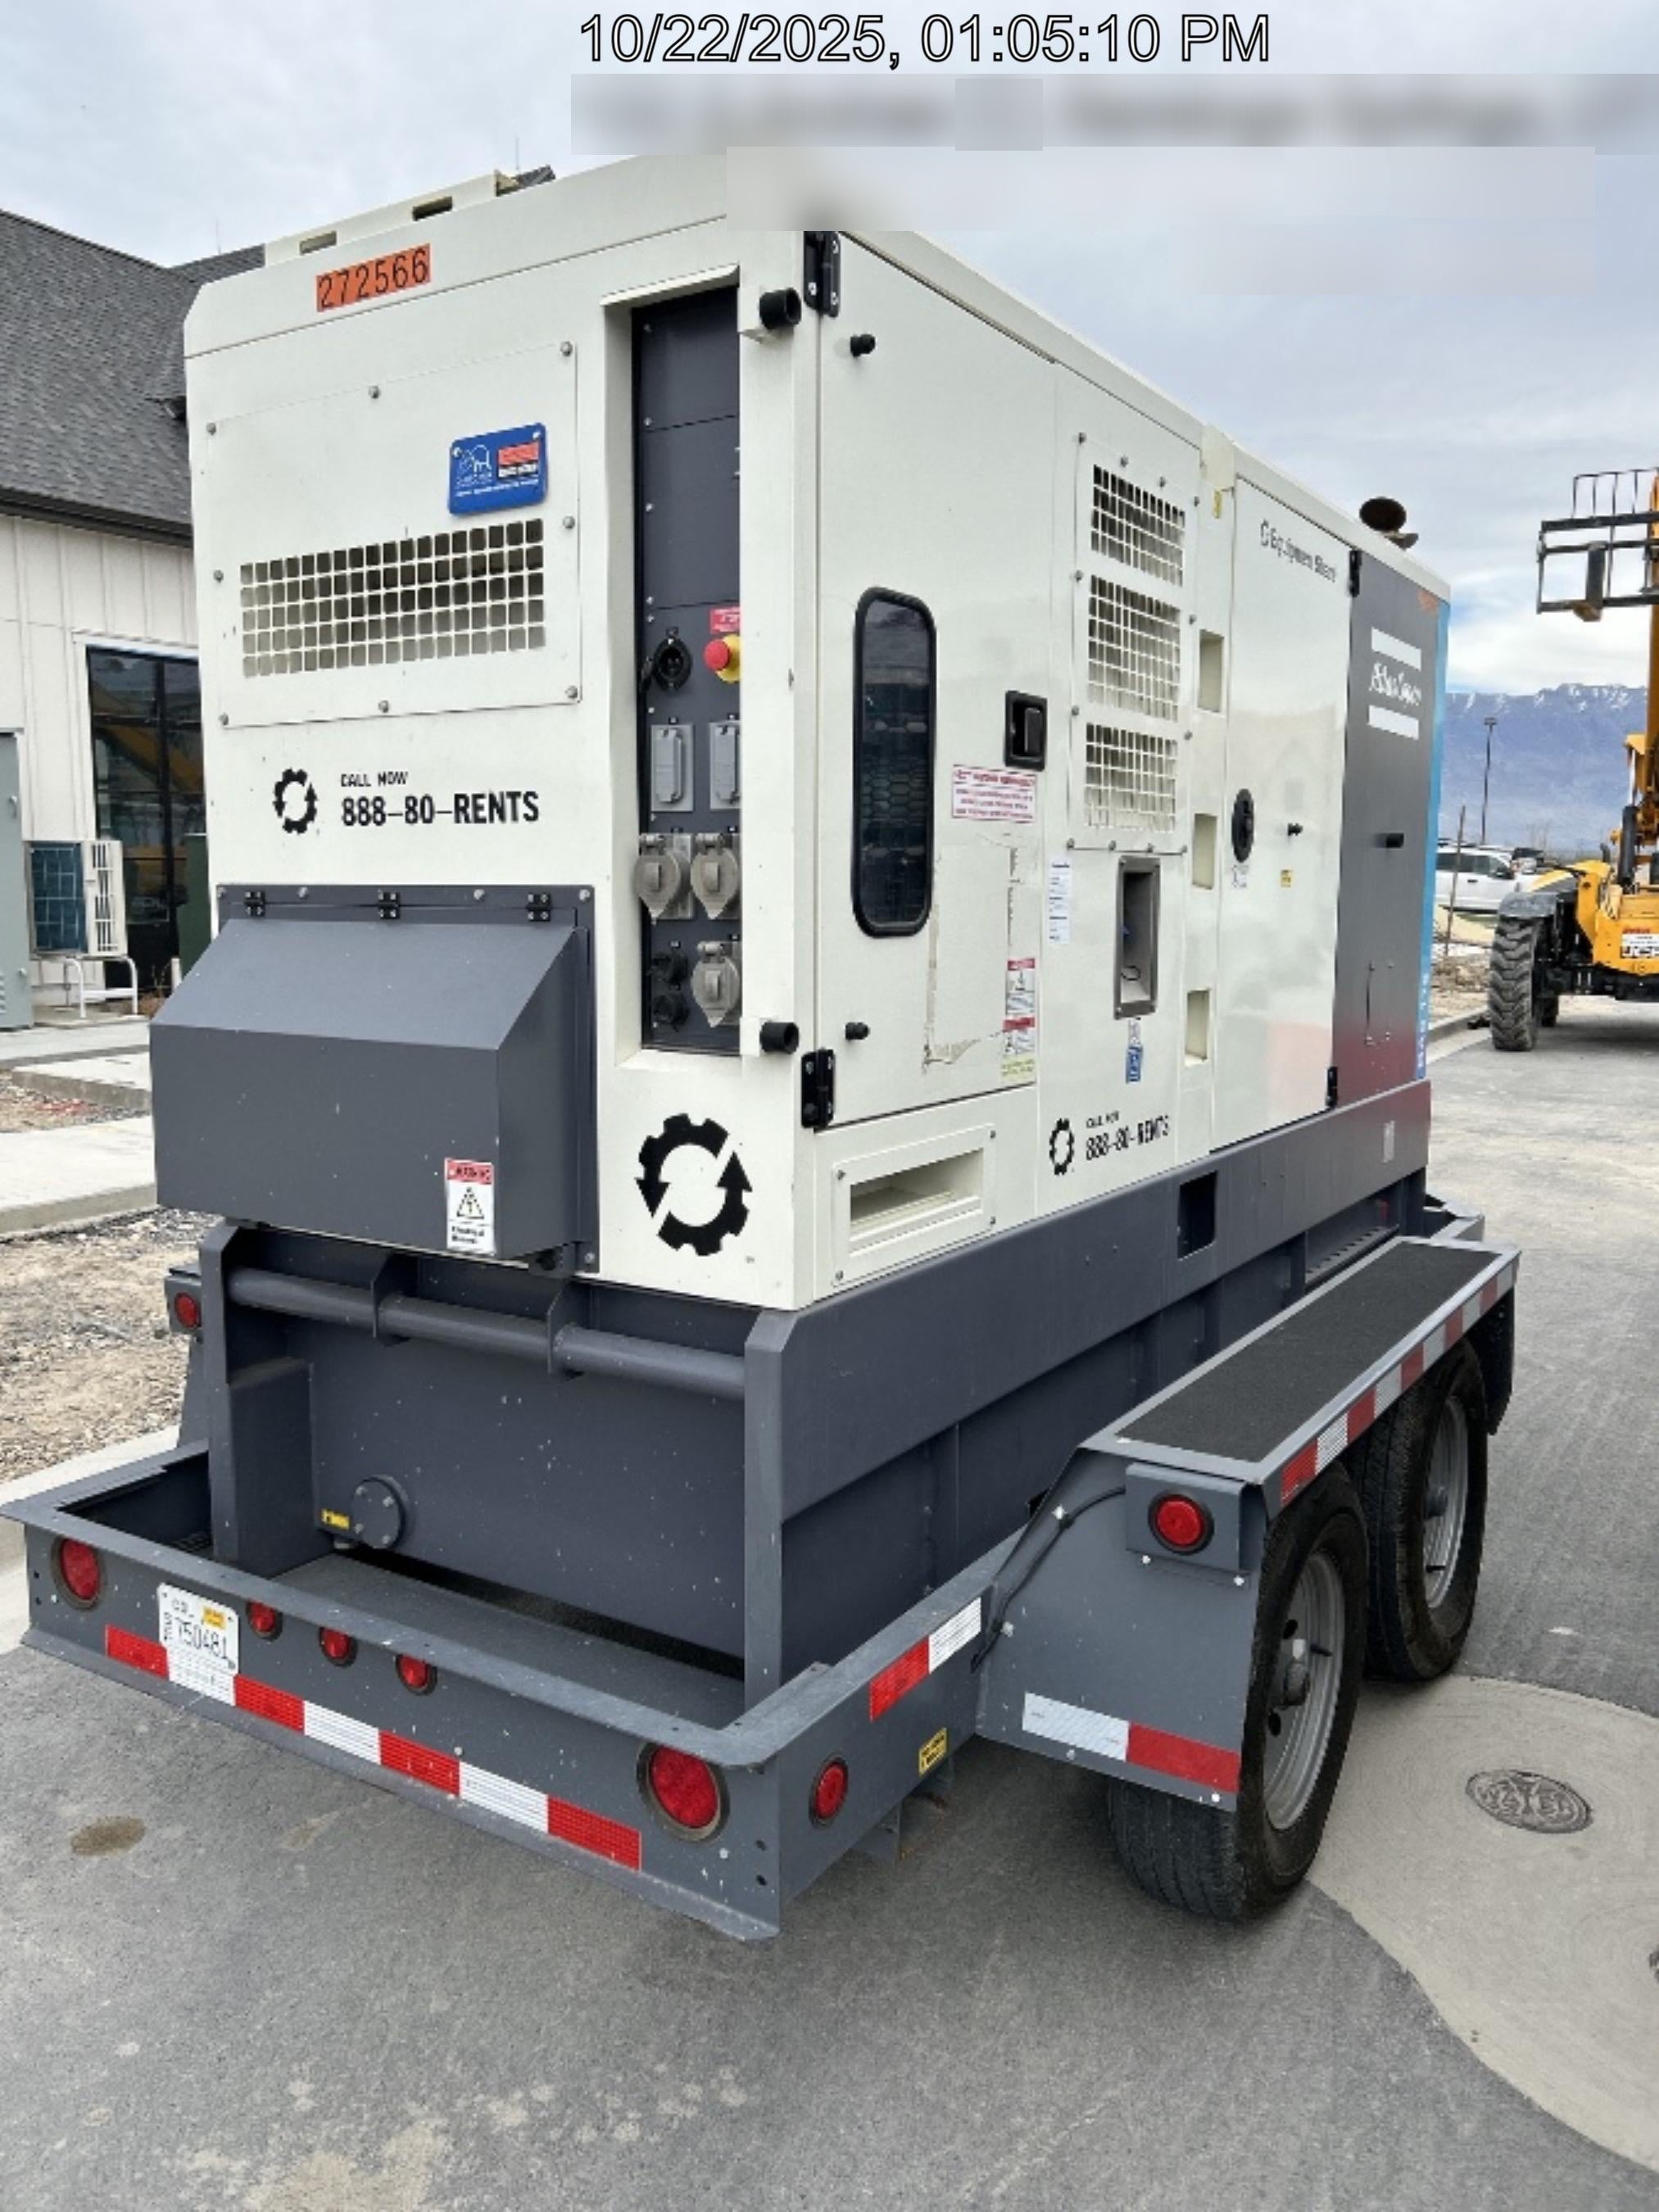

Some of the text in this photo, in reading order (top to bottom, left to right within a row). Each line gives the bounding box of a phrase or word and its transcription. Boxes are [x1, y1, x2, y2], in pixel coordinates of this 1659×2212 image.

[319, 247, 428, 308] 272566
[341, 771, 408, 787] CALL NOW
[342, 789, 539, 827] 888-80-RENTS
